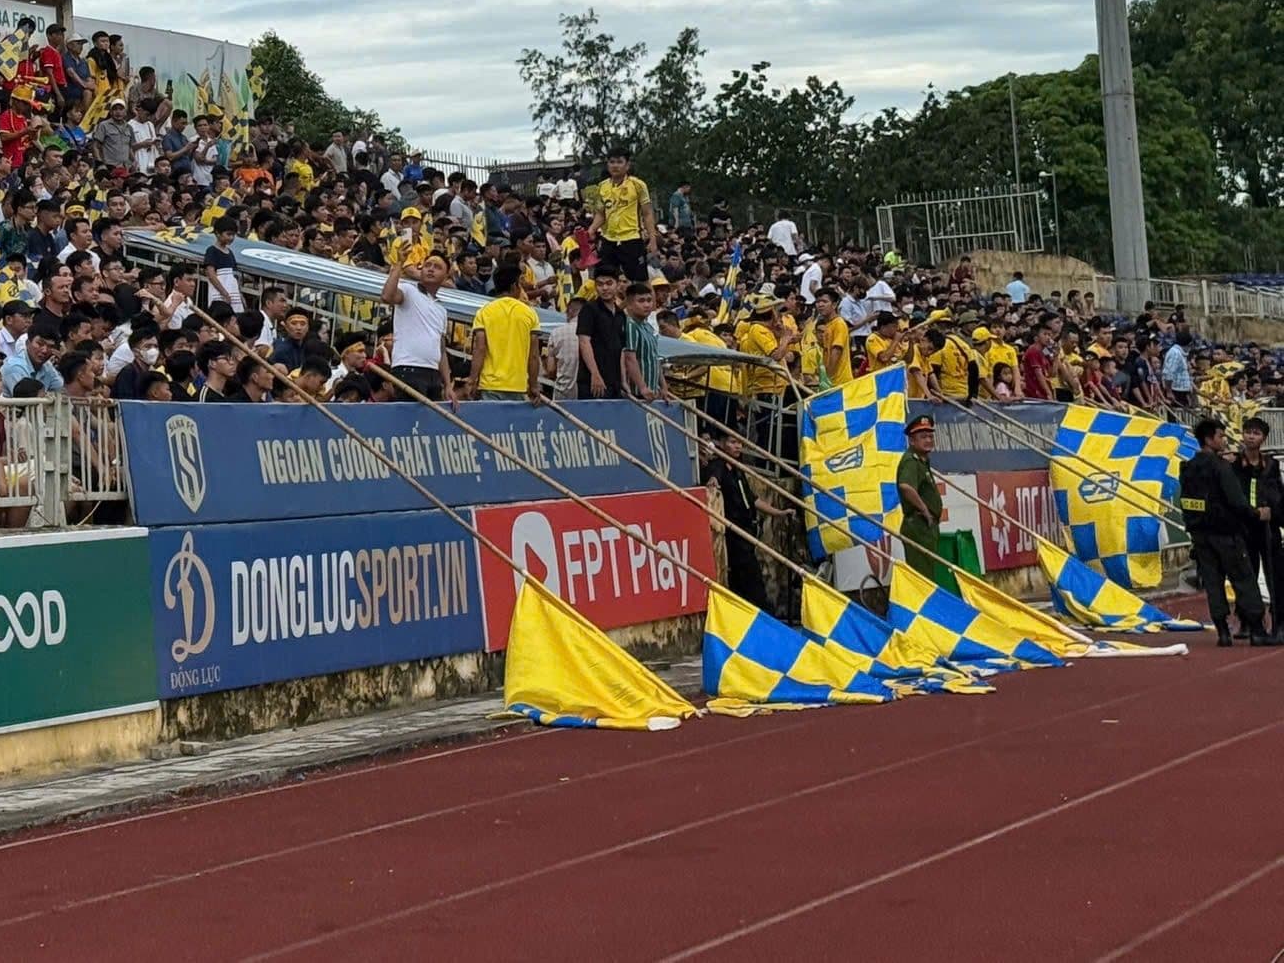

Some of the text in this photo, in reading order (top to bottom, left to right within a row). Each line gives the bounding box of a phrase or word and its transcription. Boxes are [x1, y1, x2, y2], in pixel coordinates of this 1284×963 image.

[13, 12, 45, 33] FD
[256, 439, 327, 484] NGOAN
[550, 421, 590, 469] SÔNG
[231, 540, 468, 646] DONGLUCSPORT.VN
[562, 521, 689, 607] FPT Play
